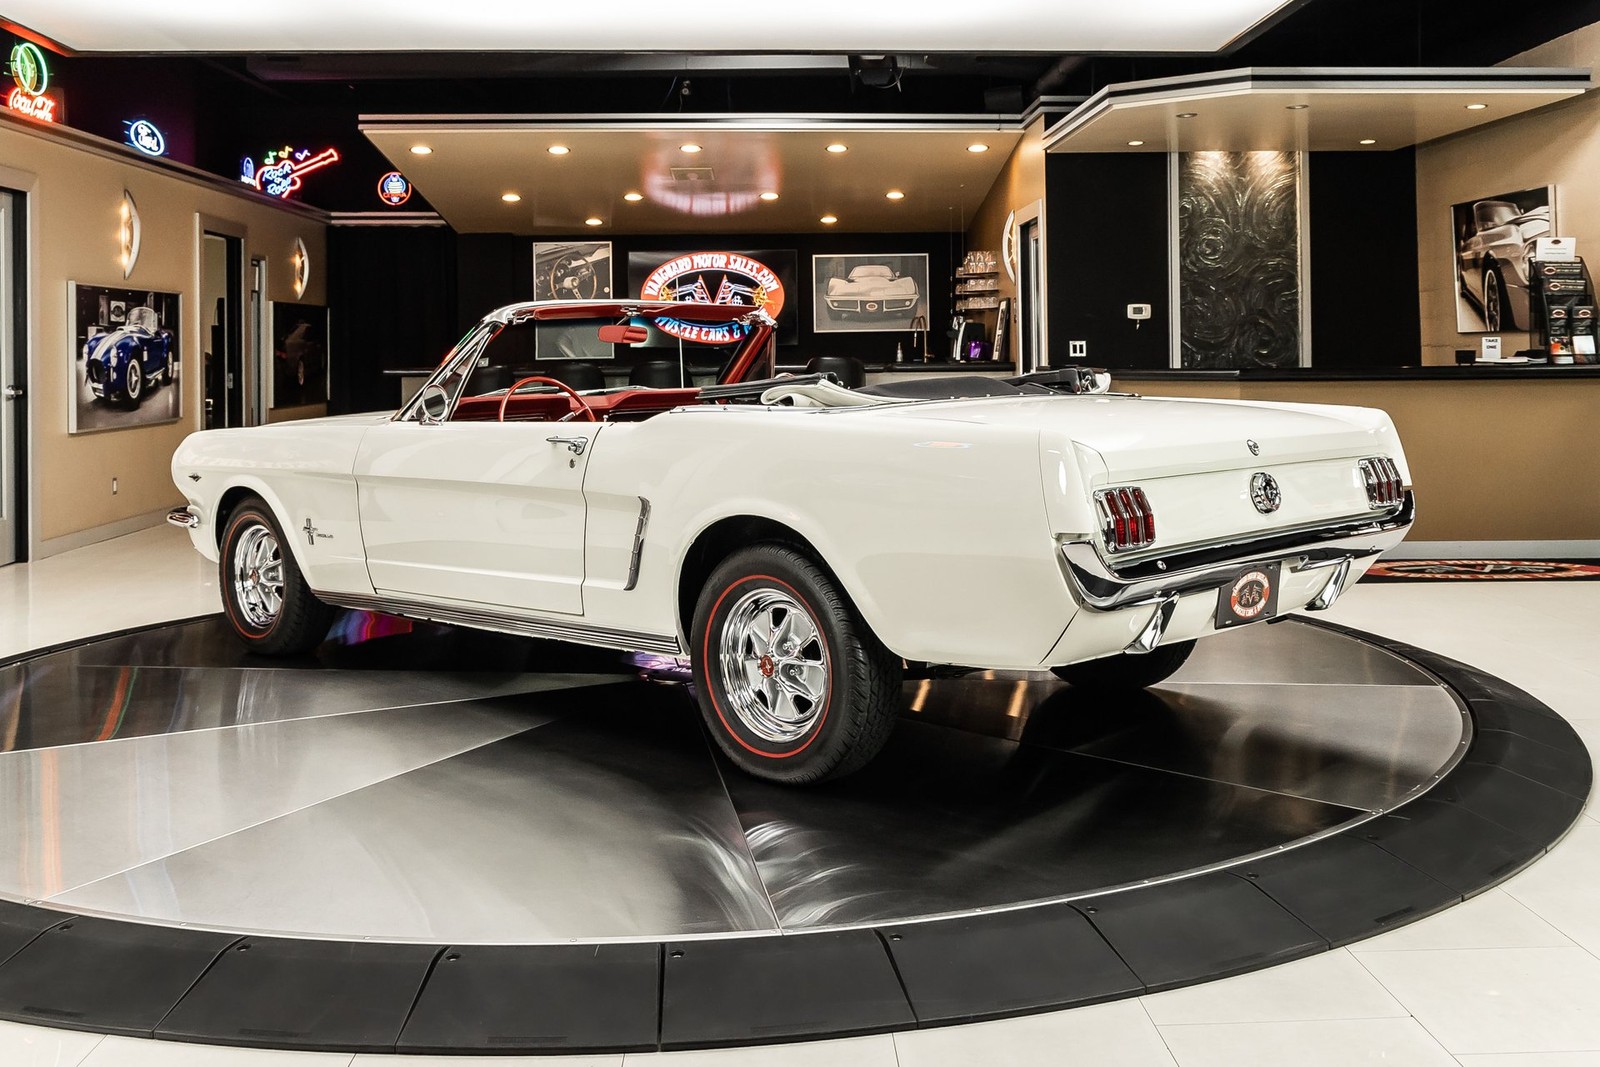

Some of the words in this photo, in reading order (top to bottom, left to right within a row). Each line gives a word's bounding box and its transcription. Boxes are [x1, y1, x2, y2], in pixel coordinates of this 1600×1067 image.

[262, 163, 292, 182] Rock
[267, 177, 292, 195] Roll
[644, 256, 693, 296] VANGUARD
[692, 253, 727, 269] MOTOR
[728, 255, 780, 293] SALES.COM
[654, 316, 702, 341] MUSCLE
[700, 325, 731, 342] CARS
